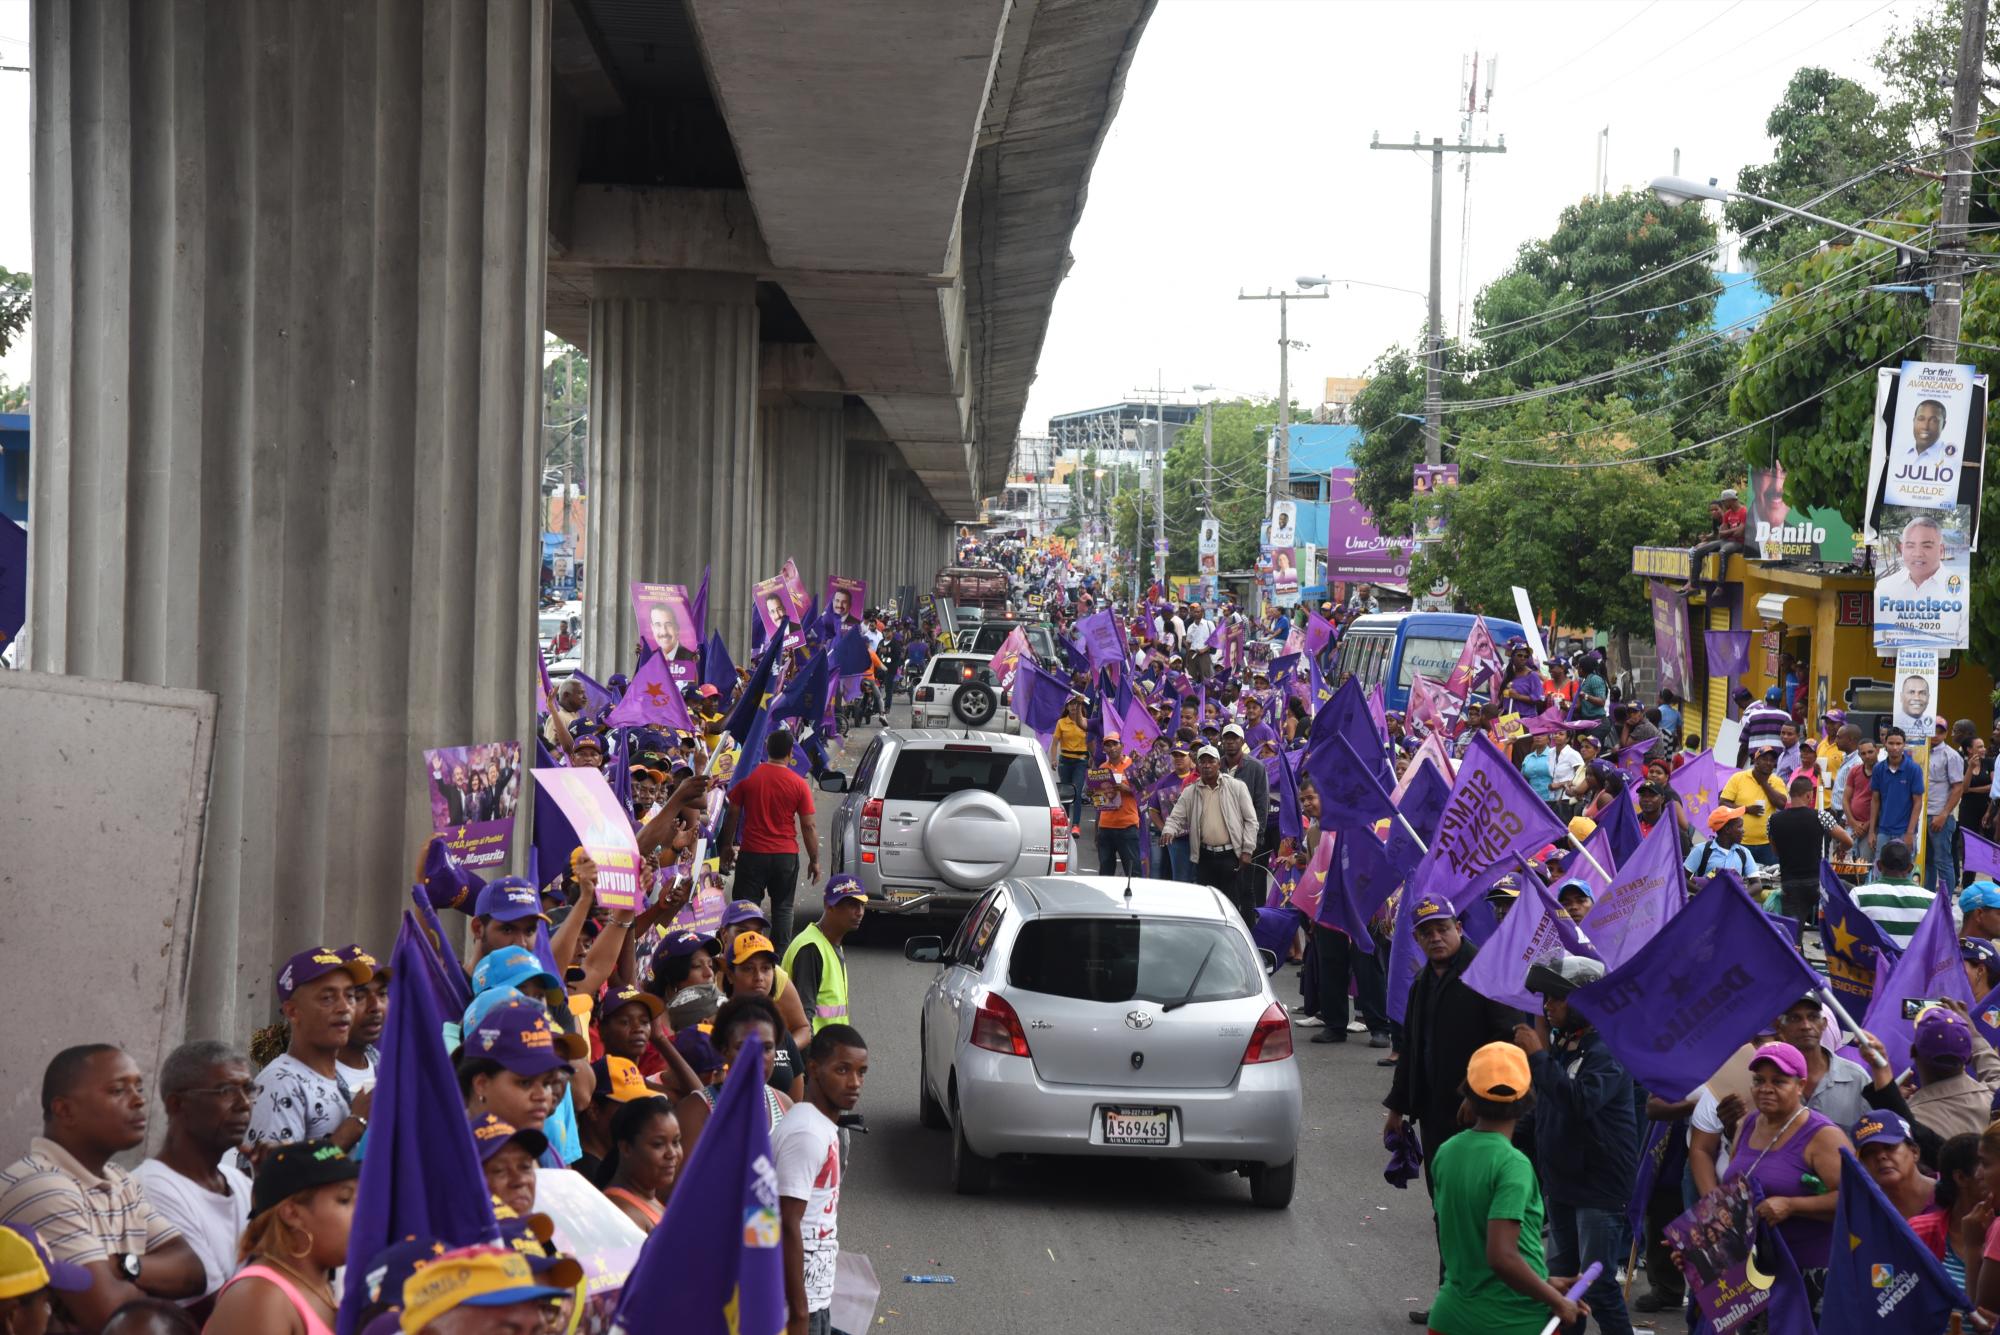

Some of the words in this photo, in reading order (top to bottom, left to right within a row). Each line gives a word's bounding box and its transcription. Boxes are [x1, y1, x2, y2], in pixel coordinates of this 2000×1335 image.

[1922, 367, 1937, 376] Por
[1907, 379, 1964, 391] AVANZANDO
[1895, 463, 1954, 483] JULIO
[1898, 484, 1945, 497] ALCALDE
[1755, 520, 1827, 544] Danilo
[1345, 536, 1369, 549] Una
[1764, 542, 1812, 556] PRESIDENTE
[1879, 595, 1962, 613] Francisco
[1897, 612, 1941, 621] ALCALDE
[464, 848, 505, 866] Margarita
[1713, 1303, 1749, 1334] Danilo
